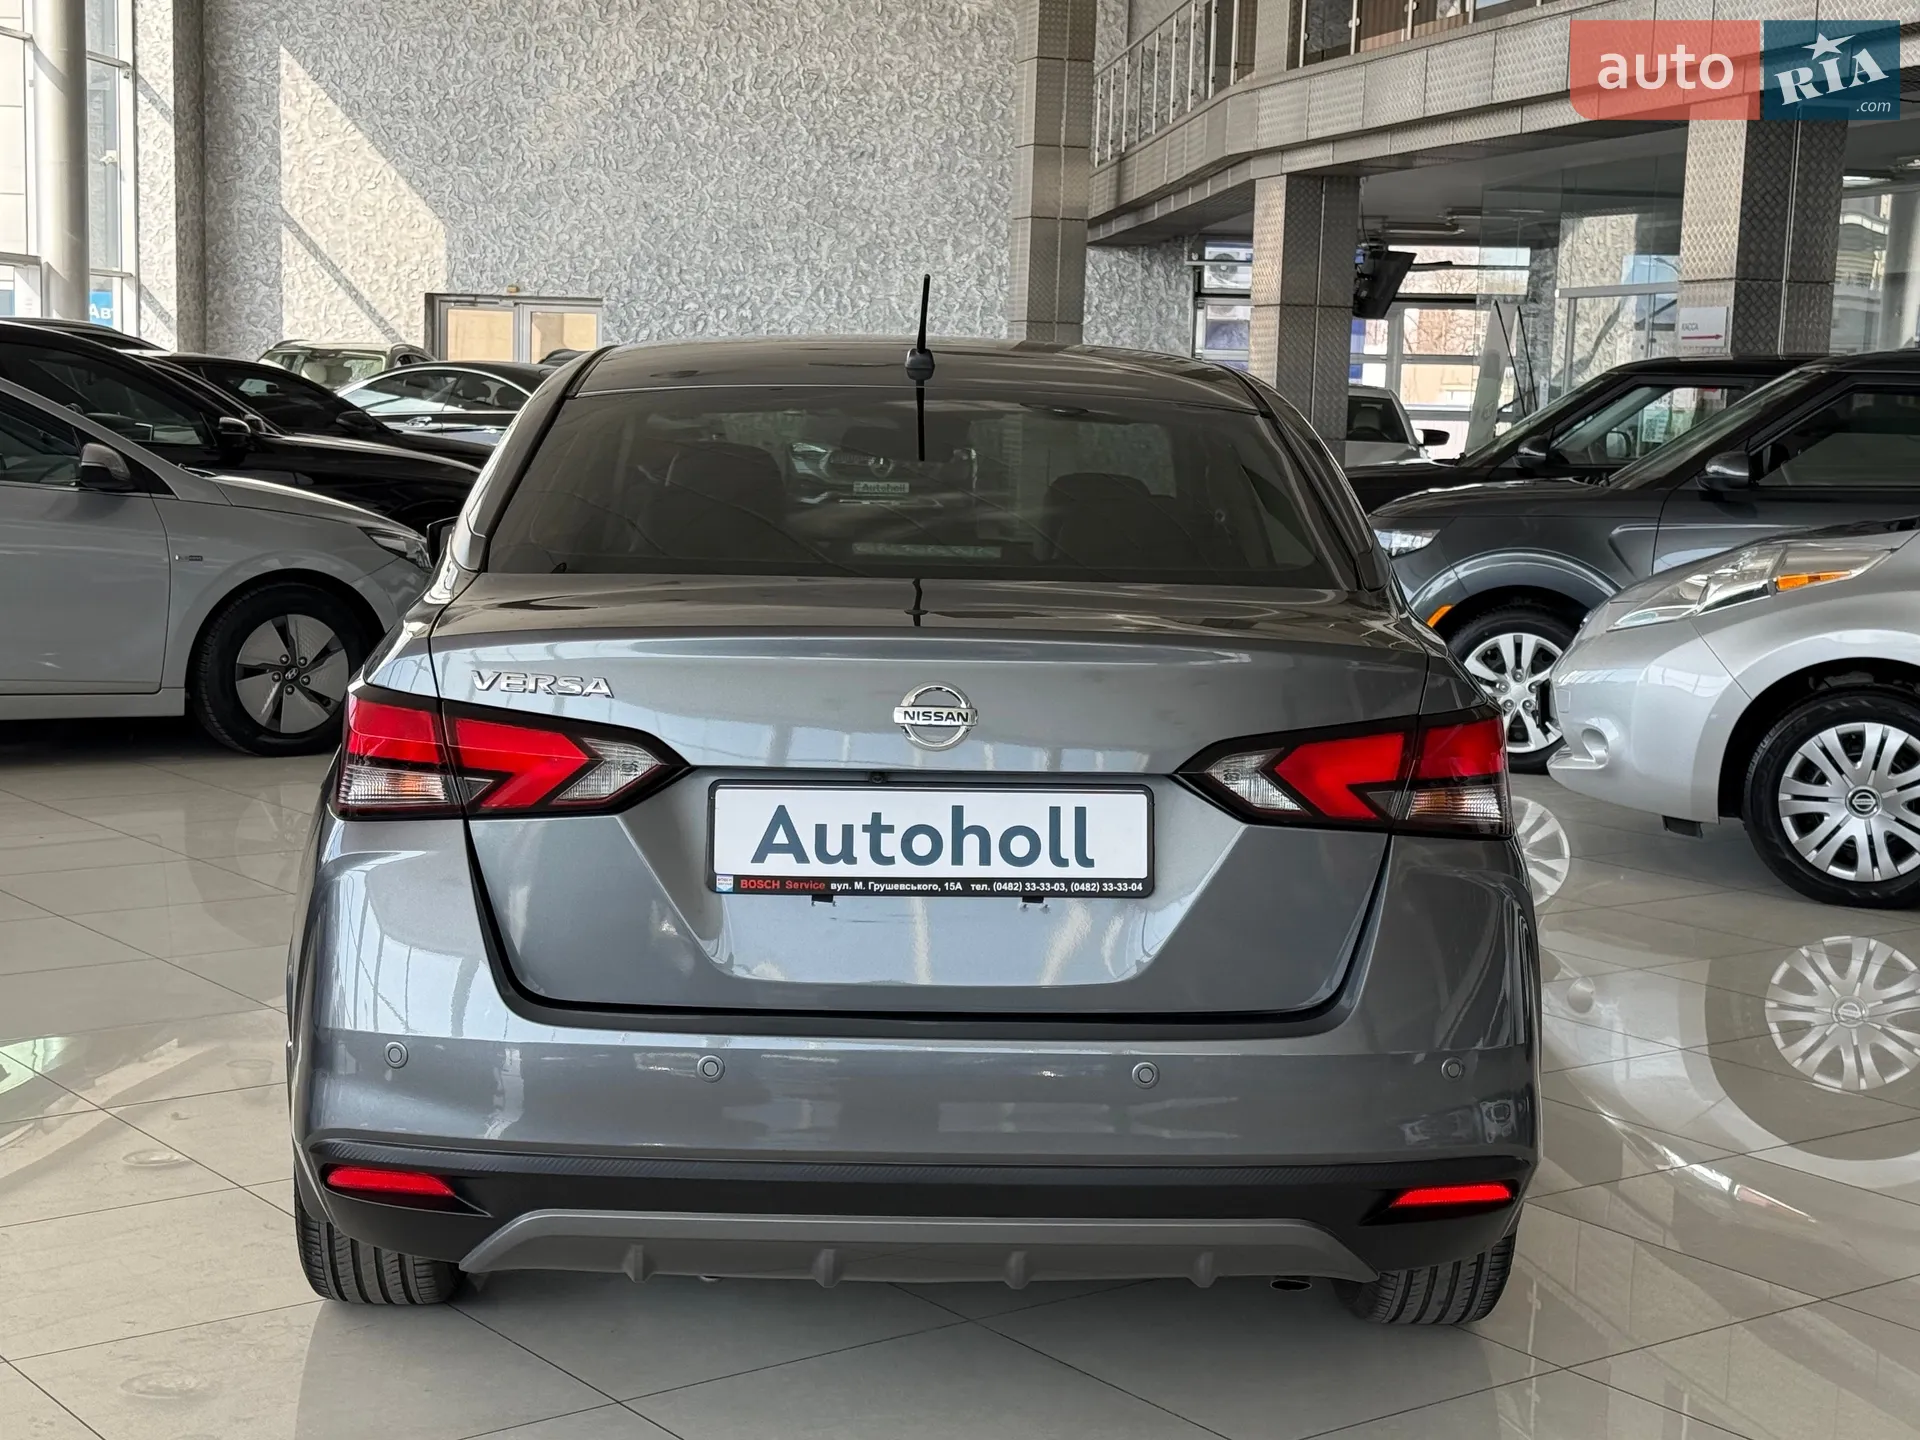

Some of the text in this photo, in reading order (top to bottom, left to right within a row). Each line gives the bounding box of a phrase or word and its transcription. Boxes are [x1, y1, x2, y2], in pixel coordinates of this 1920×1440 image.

[470, 670, 615, 699] VERSA
[904, 710, 969, 723] NISSAN
[750, 804, 1095, 868] Autoholl
[740, 879, 780, 889] BOSCH
[785, 880, 825, 890] Service
[830, 882, 852, 892] вул.
[868, 882, 942, 892] Грушевського,
[970, 883, 990, 891] тел.
[993, 882, 1023, 892] (0482)
[1024, 883, 1068, 892] 33-33-03,
[1070, 883, 1100, 893] (0482)
[1102, 883, 1143, 892] 33-33-04
